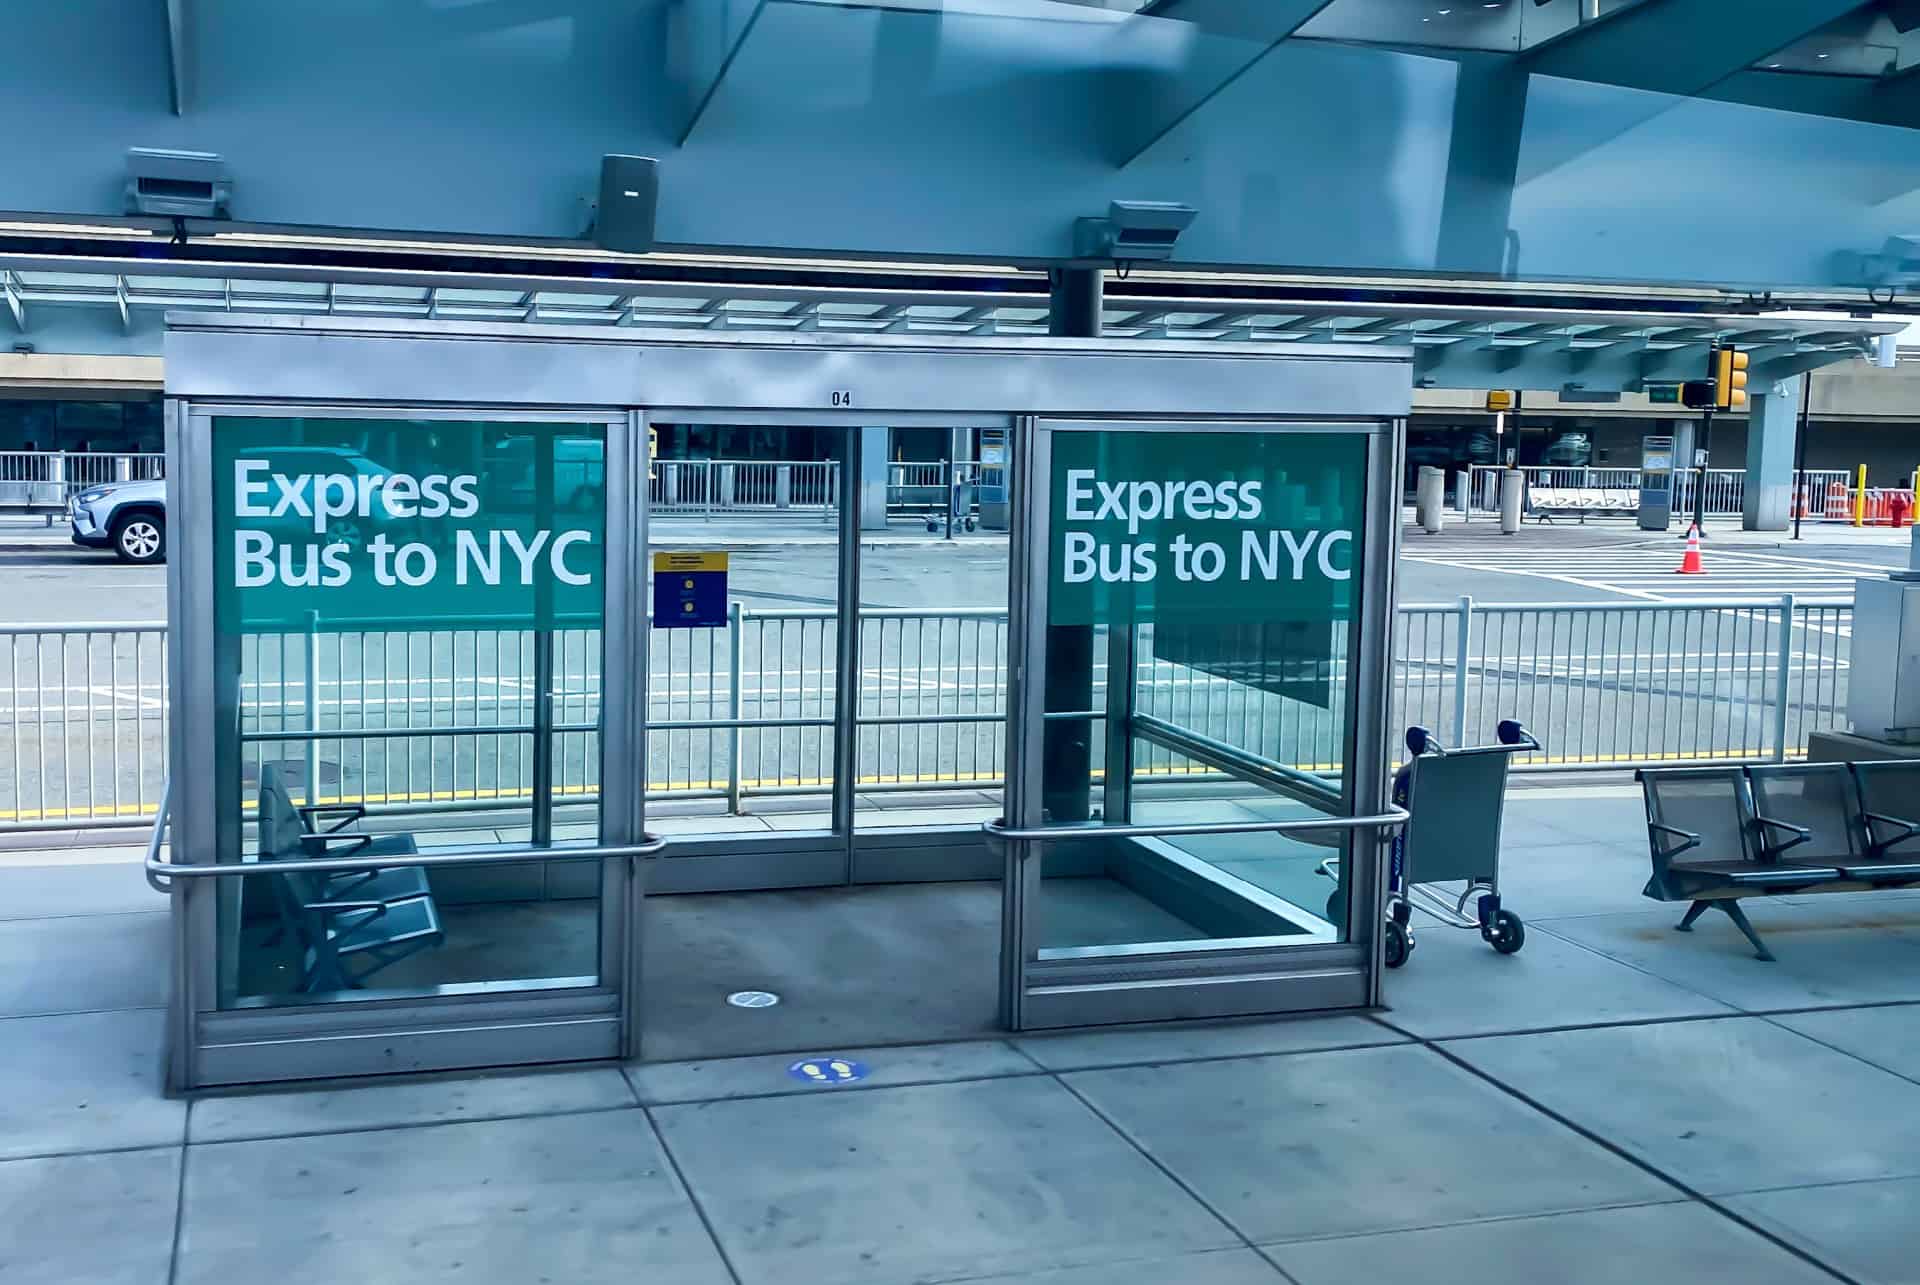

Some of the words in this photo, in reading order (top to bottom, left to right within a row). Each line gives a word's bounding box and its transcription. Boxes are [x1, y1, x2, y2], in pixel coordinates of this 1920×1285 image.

[832, 391, 850, 406] 04
[234, 459, 480, 534] Express
[1066, 468, 1262, 535] Express
[234, 530, 353, 588] Bus
[366, 533, 437, 587] to
[456, 530, 592, 587] NYC
[1063, 532, 1158, 583] Bus
[1169, 534, 1226, 583] to
[1241, 530, 1353, 582] NYC
